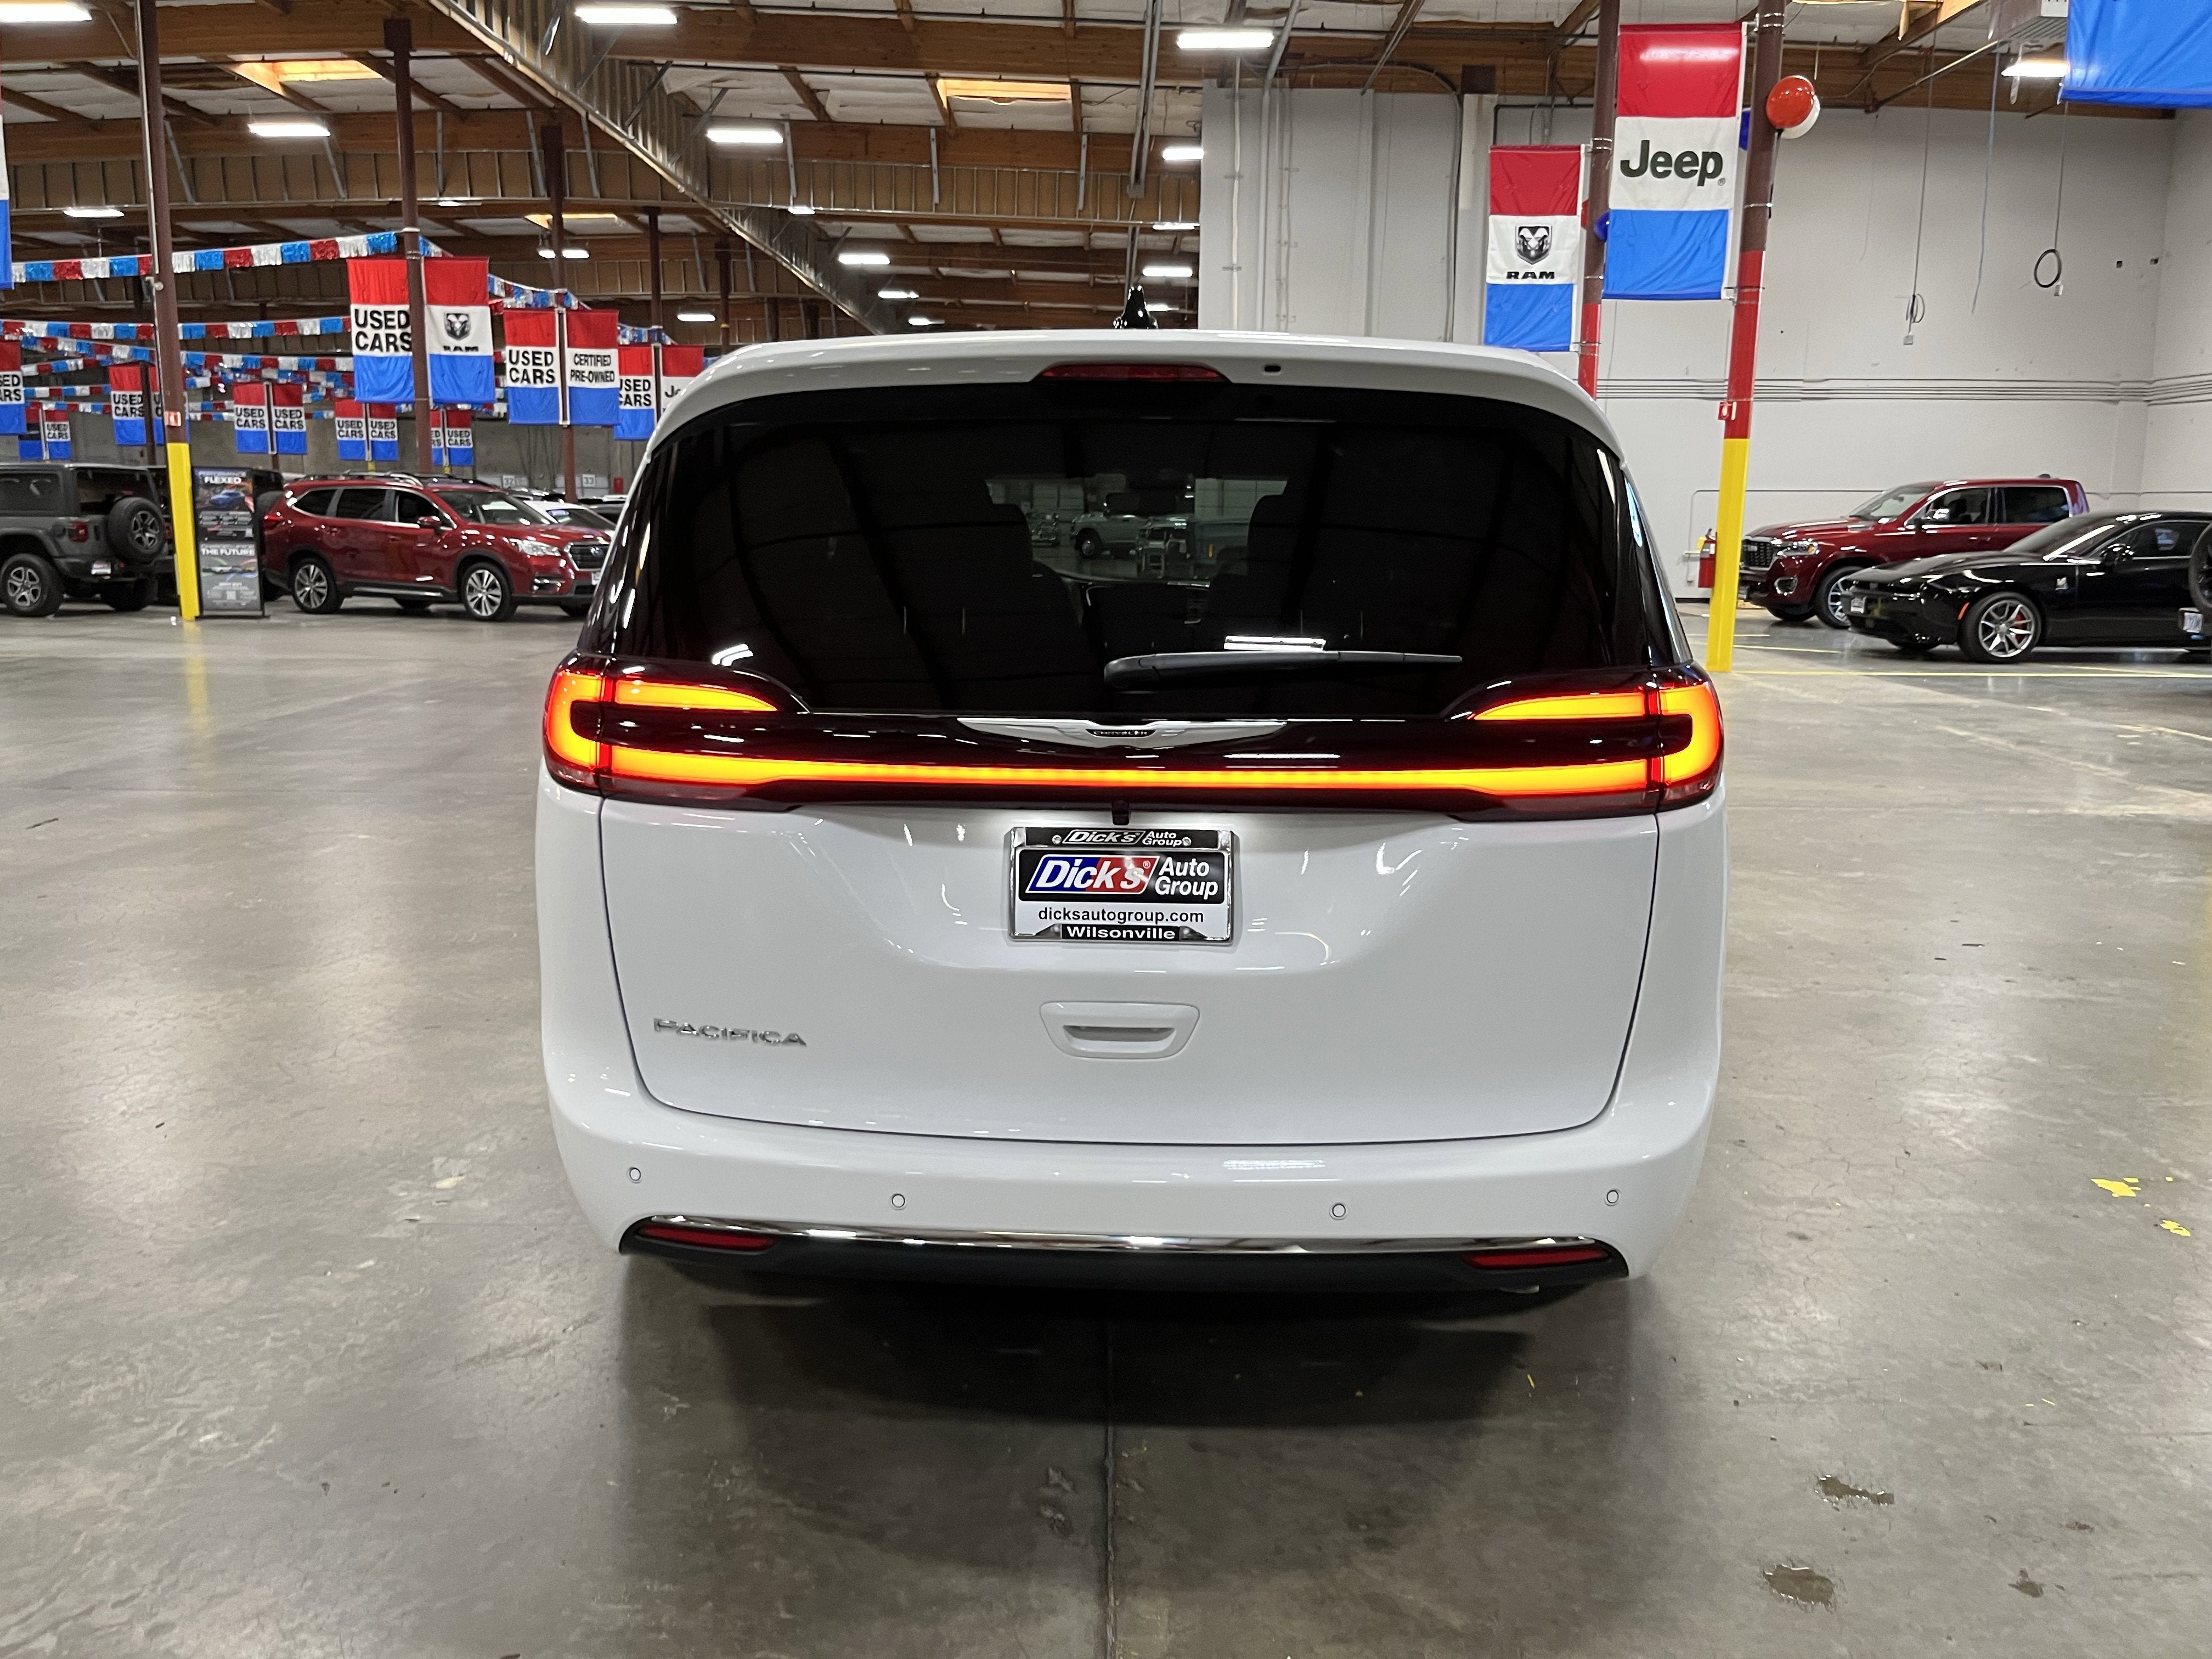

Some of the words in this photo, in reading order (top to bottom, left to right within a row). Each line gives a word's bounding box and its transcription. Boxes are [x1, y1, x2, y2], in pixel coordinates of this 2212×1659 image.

[1620, 139, 1723, 187] Jeep
[1506, 270, 1555, 280] RAM
[354, 309, 410, 329] USED
[356, 331, 412, 352] CARS
[509, 349, 554, 366] USED
[573, 353, 612, 366] CERTIFIED
[0, 375, 20, 387] ED
[509, 368, 556, 384] CARS
[570, 369, 615, 383] PRE-OWNED
[0, 389, 21, 401] RS
[236, 408, 264, 417] USED
[275, 409, 302, 419] USED
[236, 419, 266, 428] CARS
[275, 420, 303, 429] CARS
[337, 420, 363, 428] USED
[371, 421, 395, 430] USED
[338, 430, 363, 438] CARS
[371, 430, 396, 438] CARS
[204, 476, 241, 484] FLEXED
[1142, 838, 1182, 847] Group
[1158, 857, 1210, 877] Auto
[1155, 876, 1218, 900] Group
[1038, 907, 1204, 924] dicksautogroup.com
[1066, 926, 1176, 940] Wilsonville
[653, 1018, 807, 1047] PACIFICA
